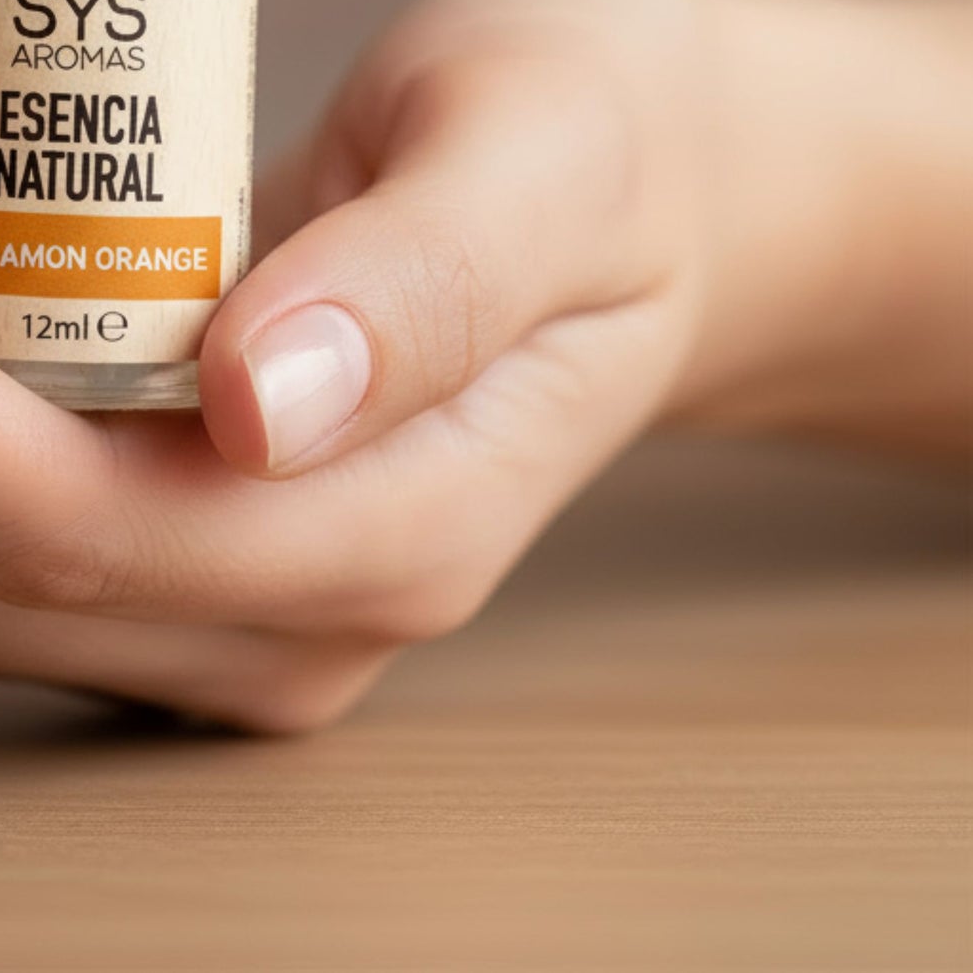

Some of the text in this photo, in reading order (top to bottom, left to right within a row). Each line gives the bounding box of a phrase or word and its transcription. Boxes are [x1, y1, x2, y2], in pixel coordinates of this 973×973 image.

[11, 42, 145, 72] AROMAS
[0, 90, 162, 145] ESENCIA
[95, 245, 208, 272] ORANGE
[22, 313, 89, 341] 12ml
